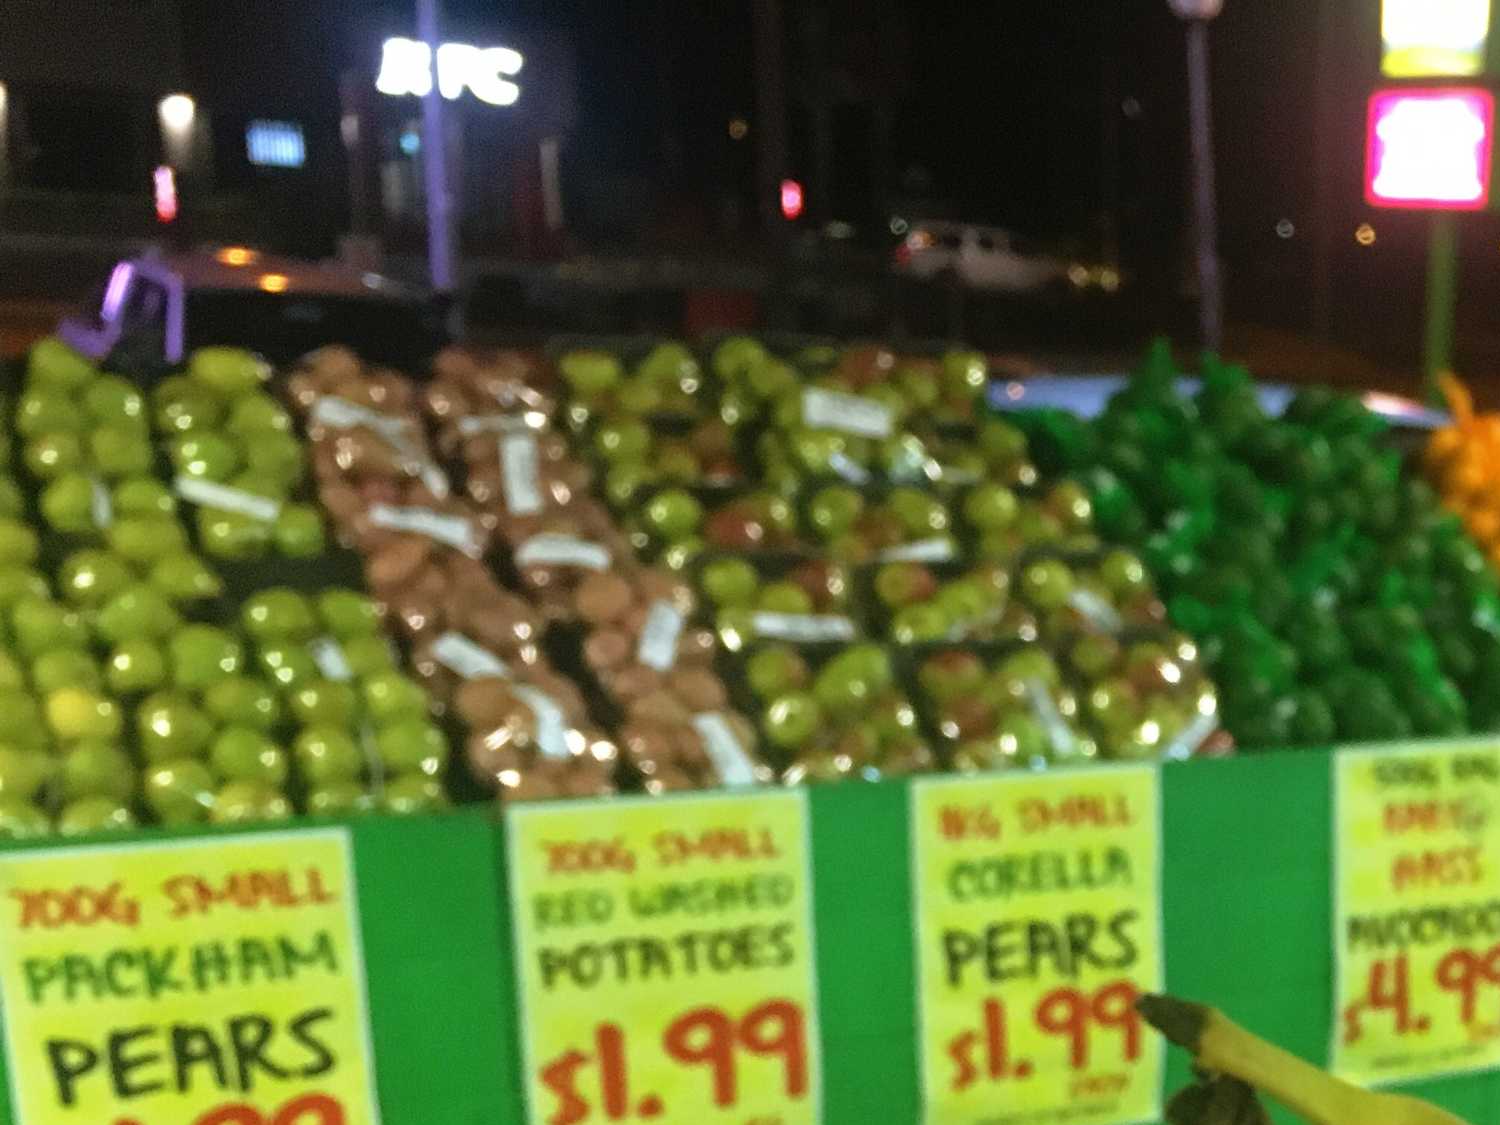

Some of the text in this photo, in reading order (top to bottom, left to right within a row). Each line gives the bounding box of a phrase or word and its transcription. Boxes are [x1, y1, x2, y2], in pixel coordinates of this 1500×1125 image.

[652, 825, 783, 867] SMALL
[1016, 793, 1134, 837] SMALL
[9, 864, 339, 929] 700G SMALL
[531, 870, 797, 932] RED WASHED
[944, 844, 1135, 904] CORELLA
[20, 929, 343, 1006] PACKHAM
[535, 920, 797, 993] POTATOES
[939, 907, 1141, 990] PEARS
[43, 1006, 339, 1109] PEARS
[945, 978, 1145, 1094] $1.99
